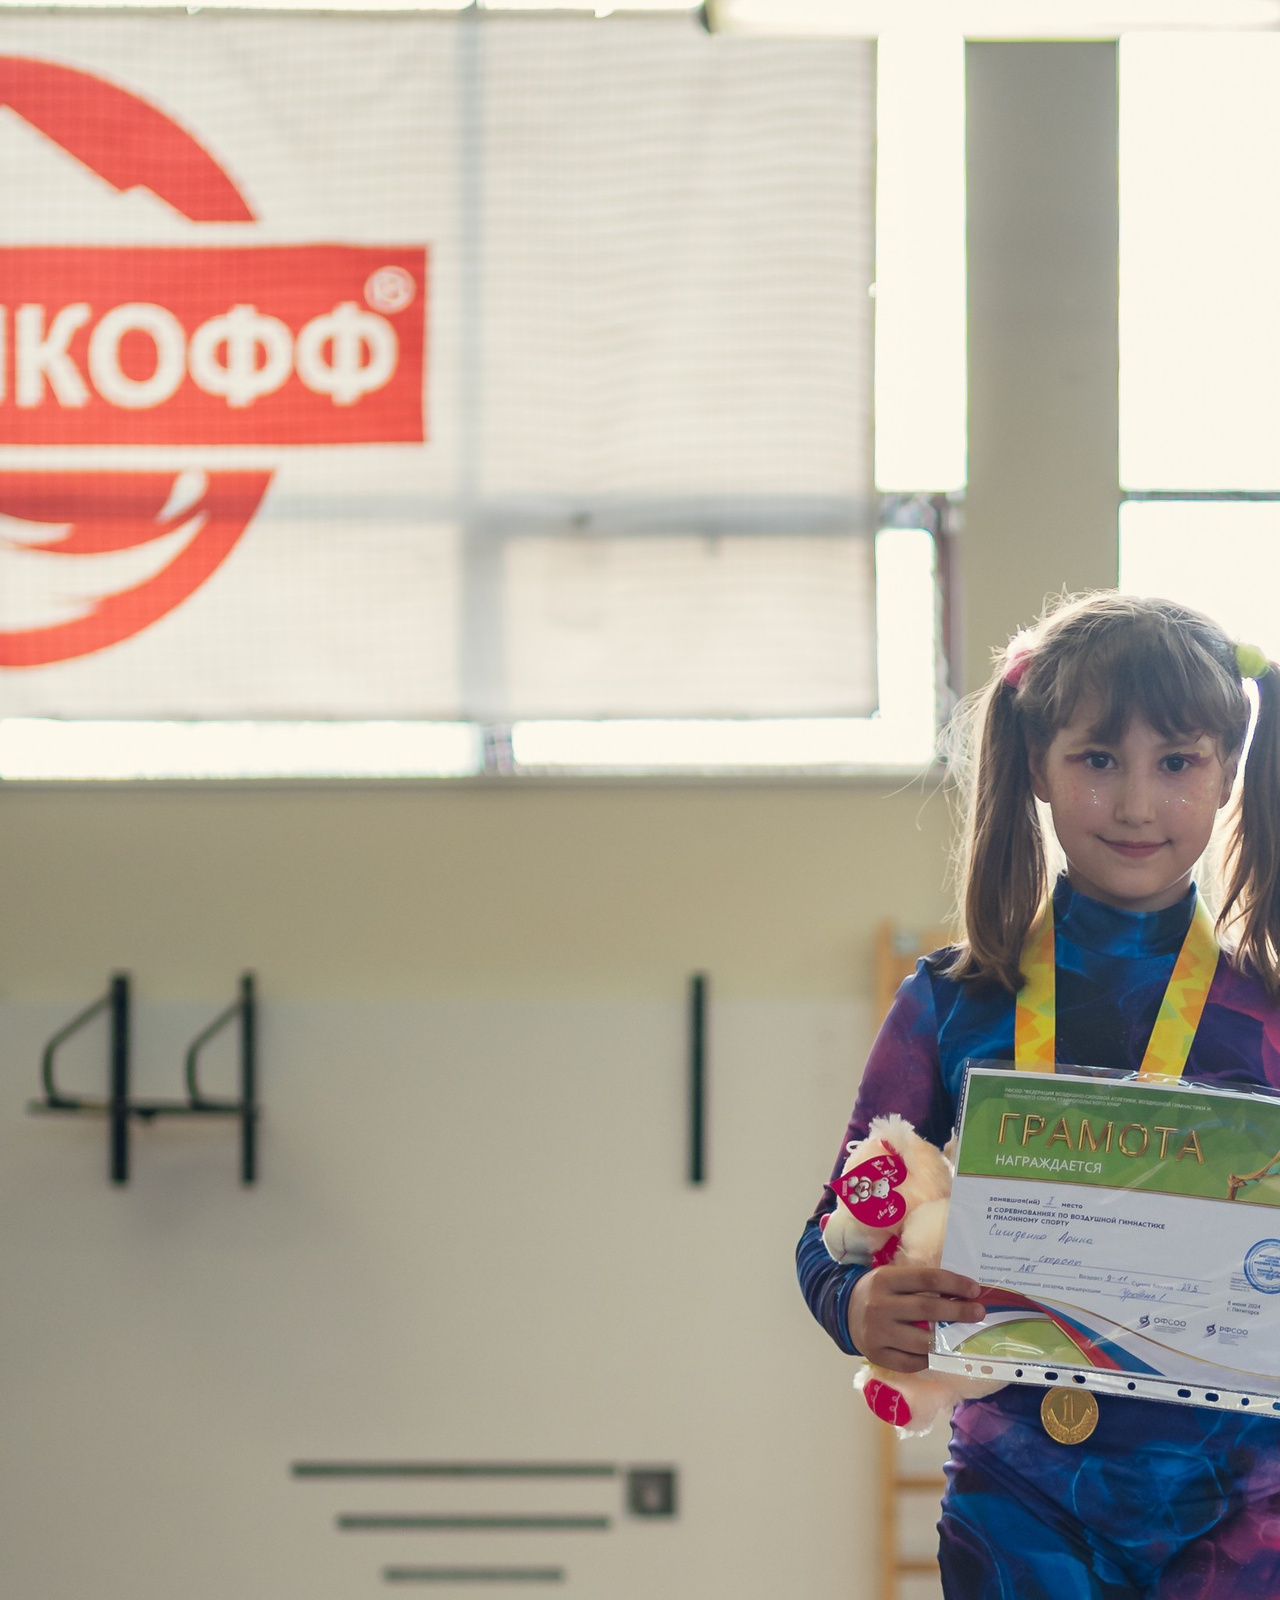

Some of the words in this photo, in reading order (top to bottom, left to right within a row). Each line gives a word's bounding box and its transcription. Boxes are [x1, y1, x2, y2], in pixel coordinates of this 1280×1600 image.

[0, 301, 399, 409] КОФФ
[997, 1112, 1205, 1164] ГРАМОТА
[995, 1154, 1102, 1174] НАГРАЖДАЕТСЯ
[993, 1214, 1039, 1224] ПИЛОННОМУ
[1041, 1219, 1070, 1227] СПОРТУ
[994, 1207, 1056, 1218] СОРЕВНОВАНИЯХ
[1070, 1213, 1117, 1224] ВОЗДУШНОЙ
[1118, 1219, 1166, 1230] ГИМНАСТИКЕ
[1153, 1317, 1187, 1328] ОФСОО
[1219, 1325, 1249, 1336] РФСОО
